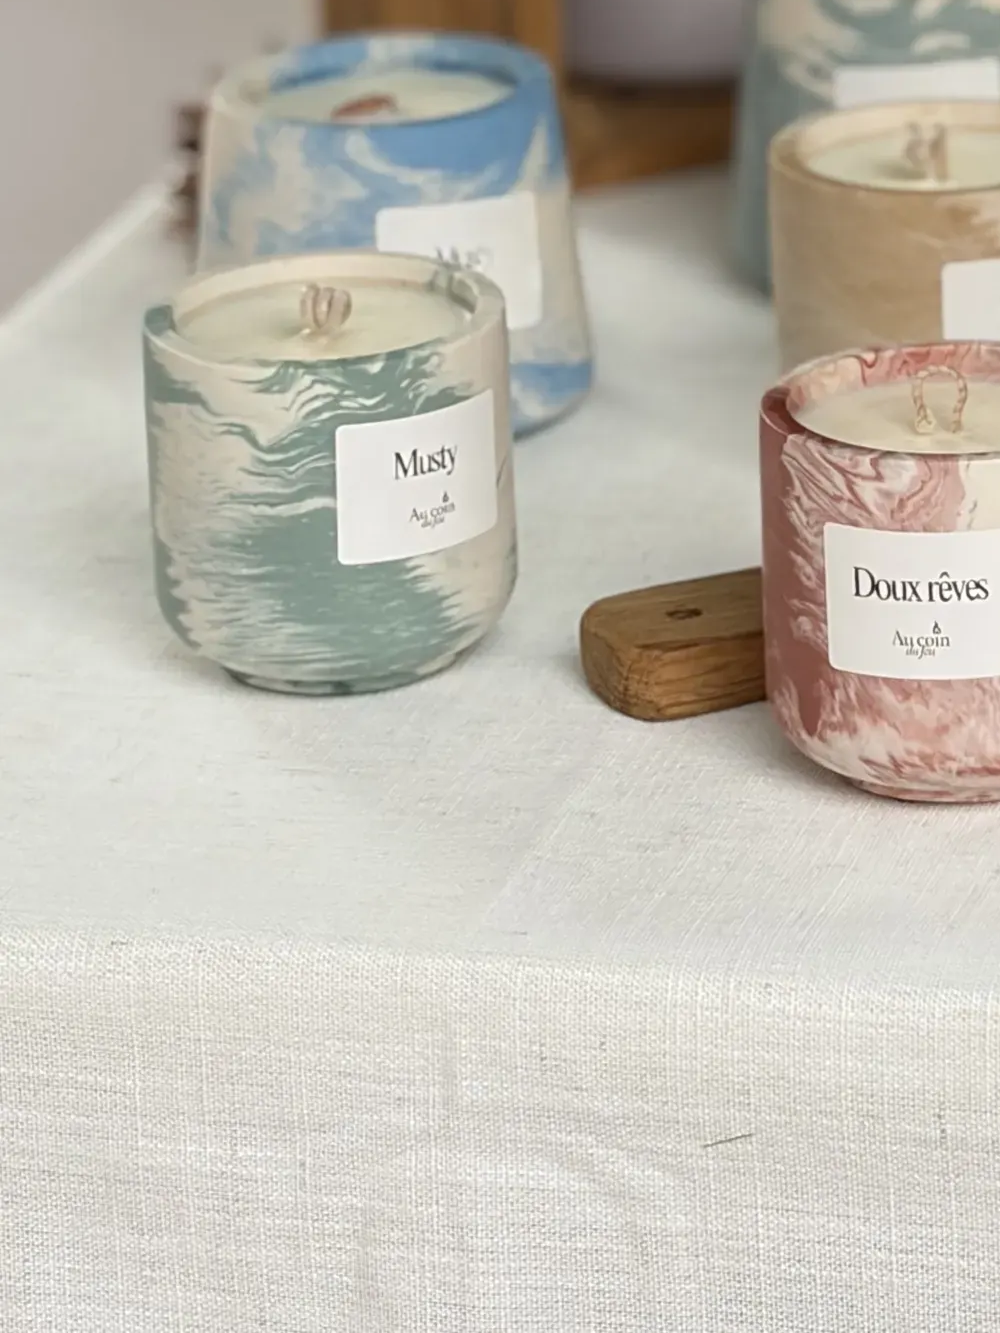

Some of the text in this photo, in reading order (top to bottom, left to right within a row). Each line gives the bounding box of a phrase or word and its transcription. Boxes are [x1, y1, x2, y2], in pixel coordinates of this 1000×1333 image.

[393, 444, 457, 480] Musty
[852, 566, 989, 602] Doux rêves
[892, 629, 951, 648] Au coin
